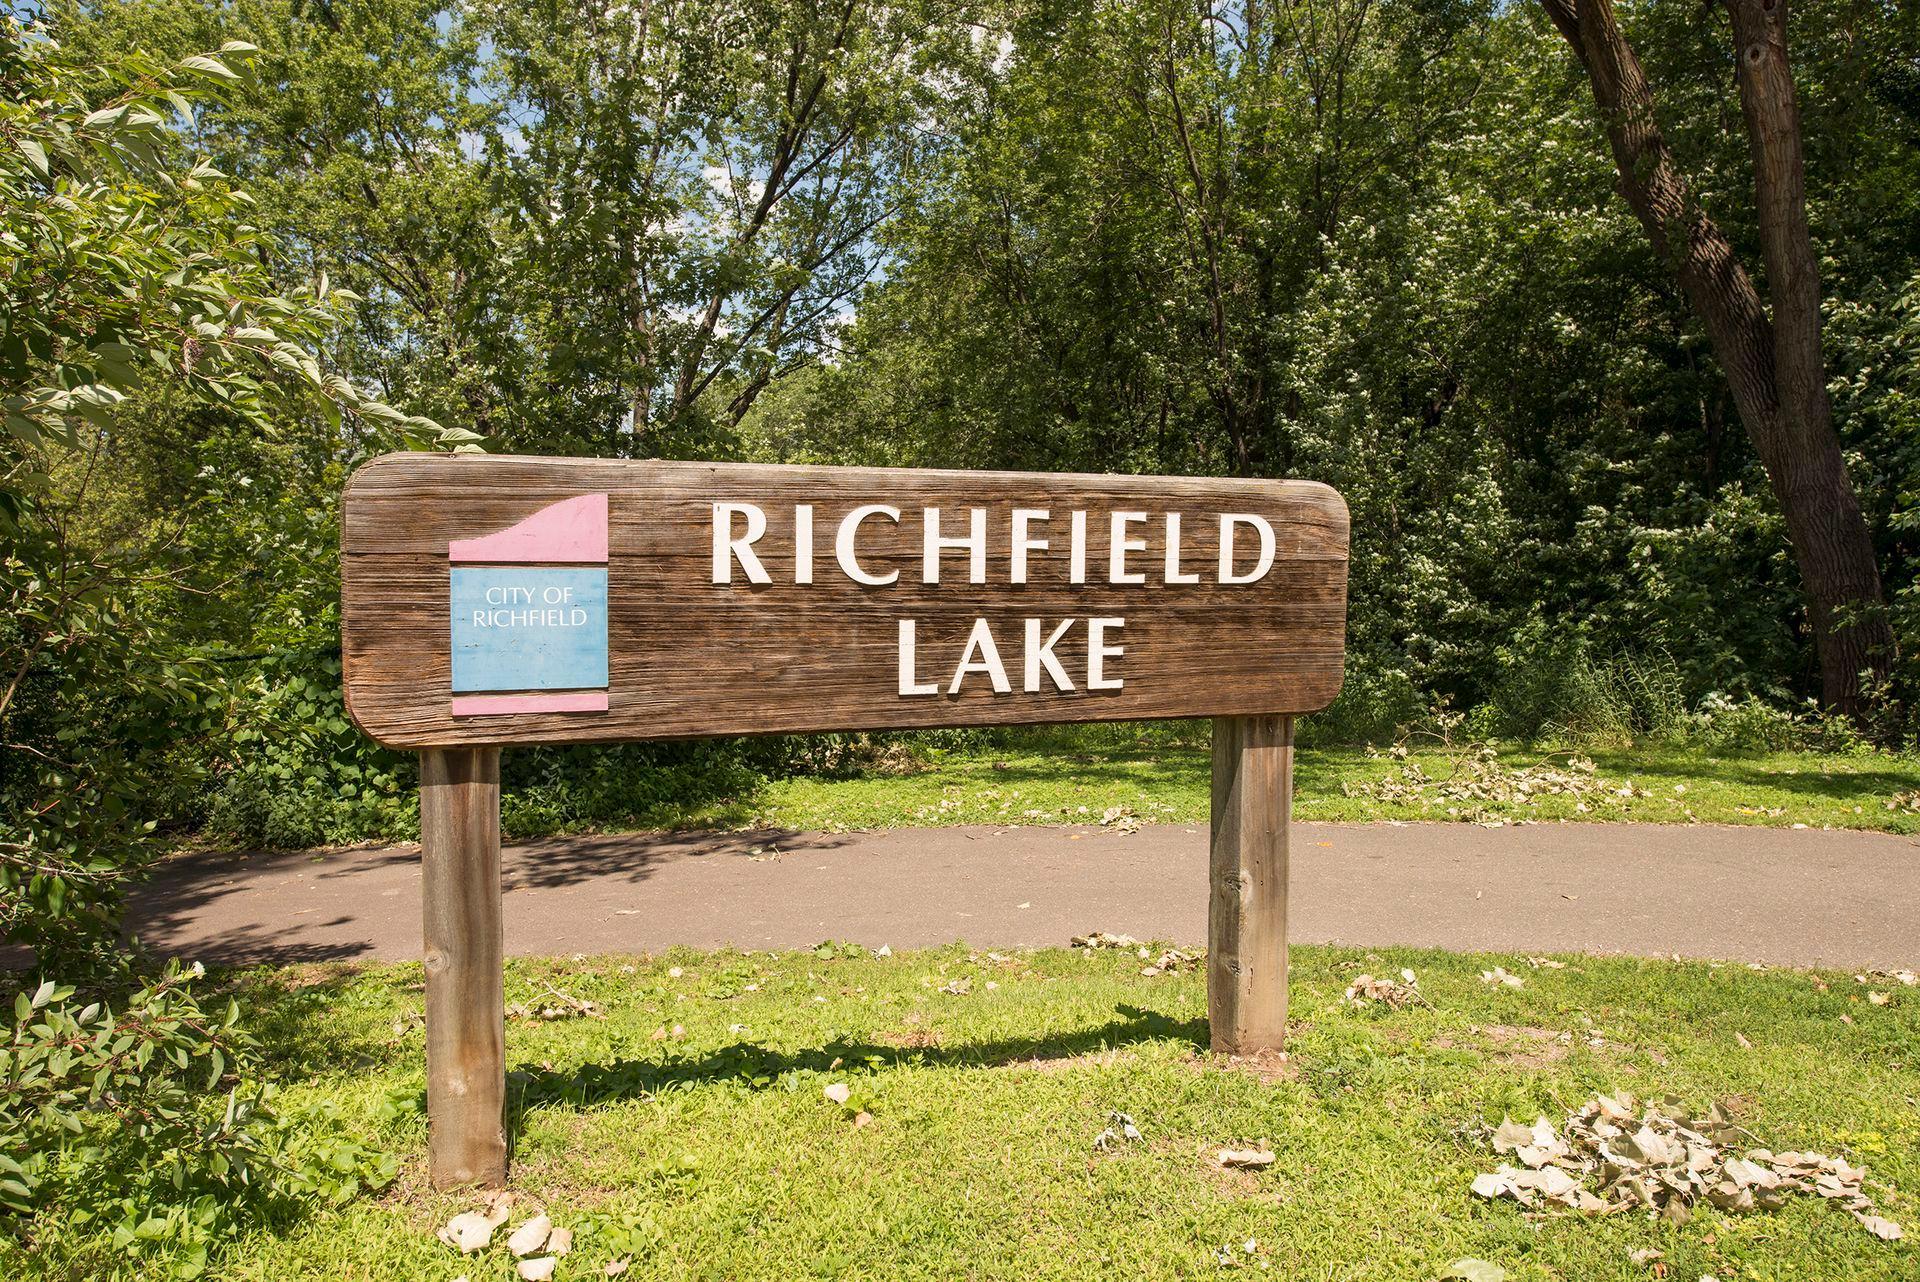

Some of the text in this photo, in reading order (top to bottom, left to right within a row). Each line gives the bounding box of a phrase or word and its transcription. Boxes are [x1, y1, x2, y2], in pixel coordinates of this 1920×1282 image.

[711, 502, 1277, 586] RICHFIELD
[473, 608, 588, 628] RICHFIELD
[486, 586, 573, 605] CITY OF
[898, 617, 1126, 696] LAKE
